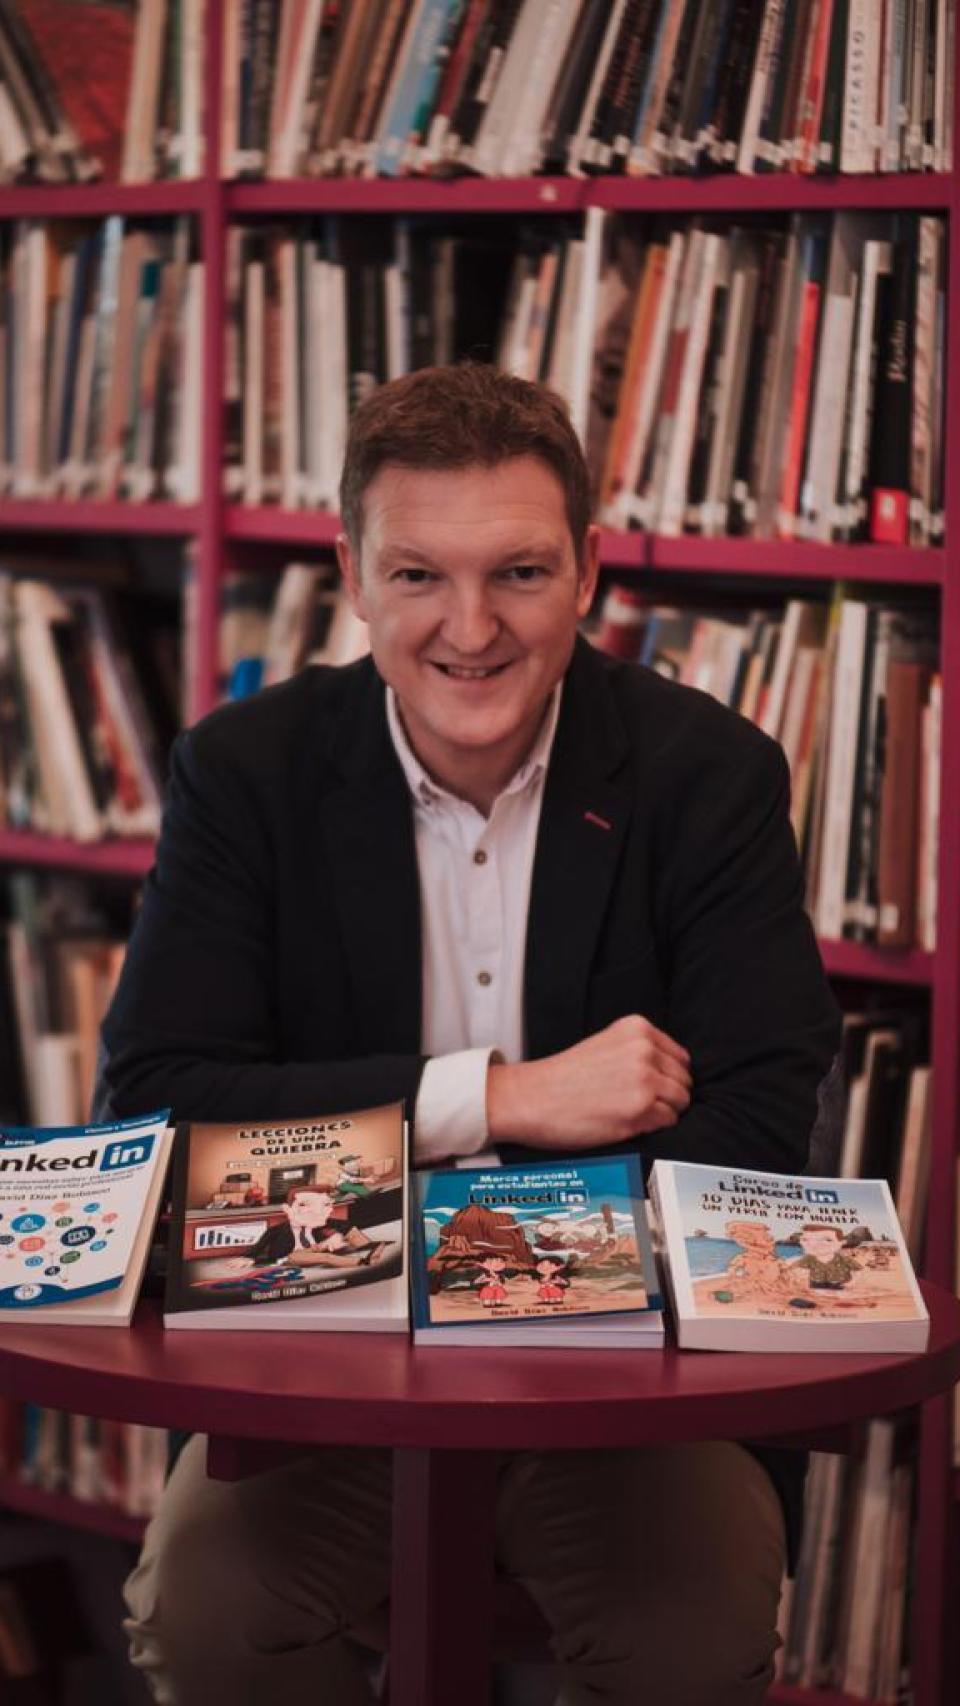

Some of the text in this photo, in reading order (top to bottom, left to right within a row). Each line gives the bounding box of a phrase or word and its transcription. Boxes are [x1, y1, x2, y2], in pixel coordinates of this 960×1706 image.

[849, 30, 866, 129] PICASSO
[239, 1120, 351, 1139] LECCIONES
[292, 1134, 326, 1144] UNA
[251, 1140, 342, 1155] QUIEBRA
[523, 1170, 578, 1183] personal
[733, 1174, 803, 1190] Curso de
[702, 1193, 722, 1203] 10
[777, 1203, 811, 1214] PARA
[702, 1203, 721, 1212] UN
[777, 1210, 804, 1220] CON
